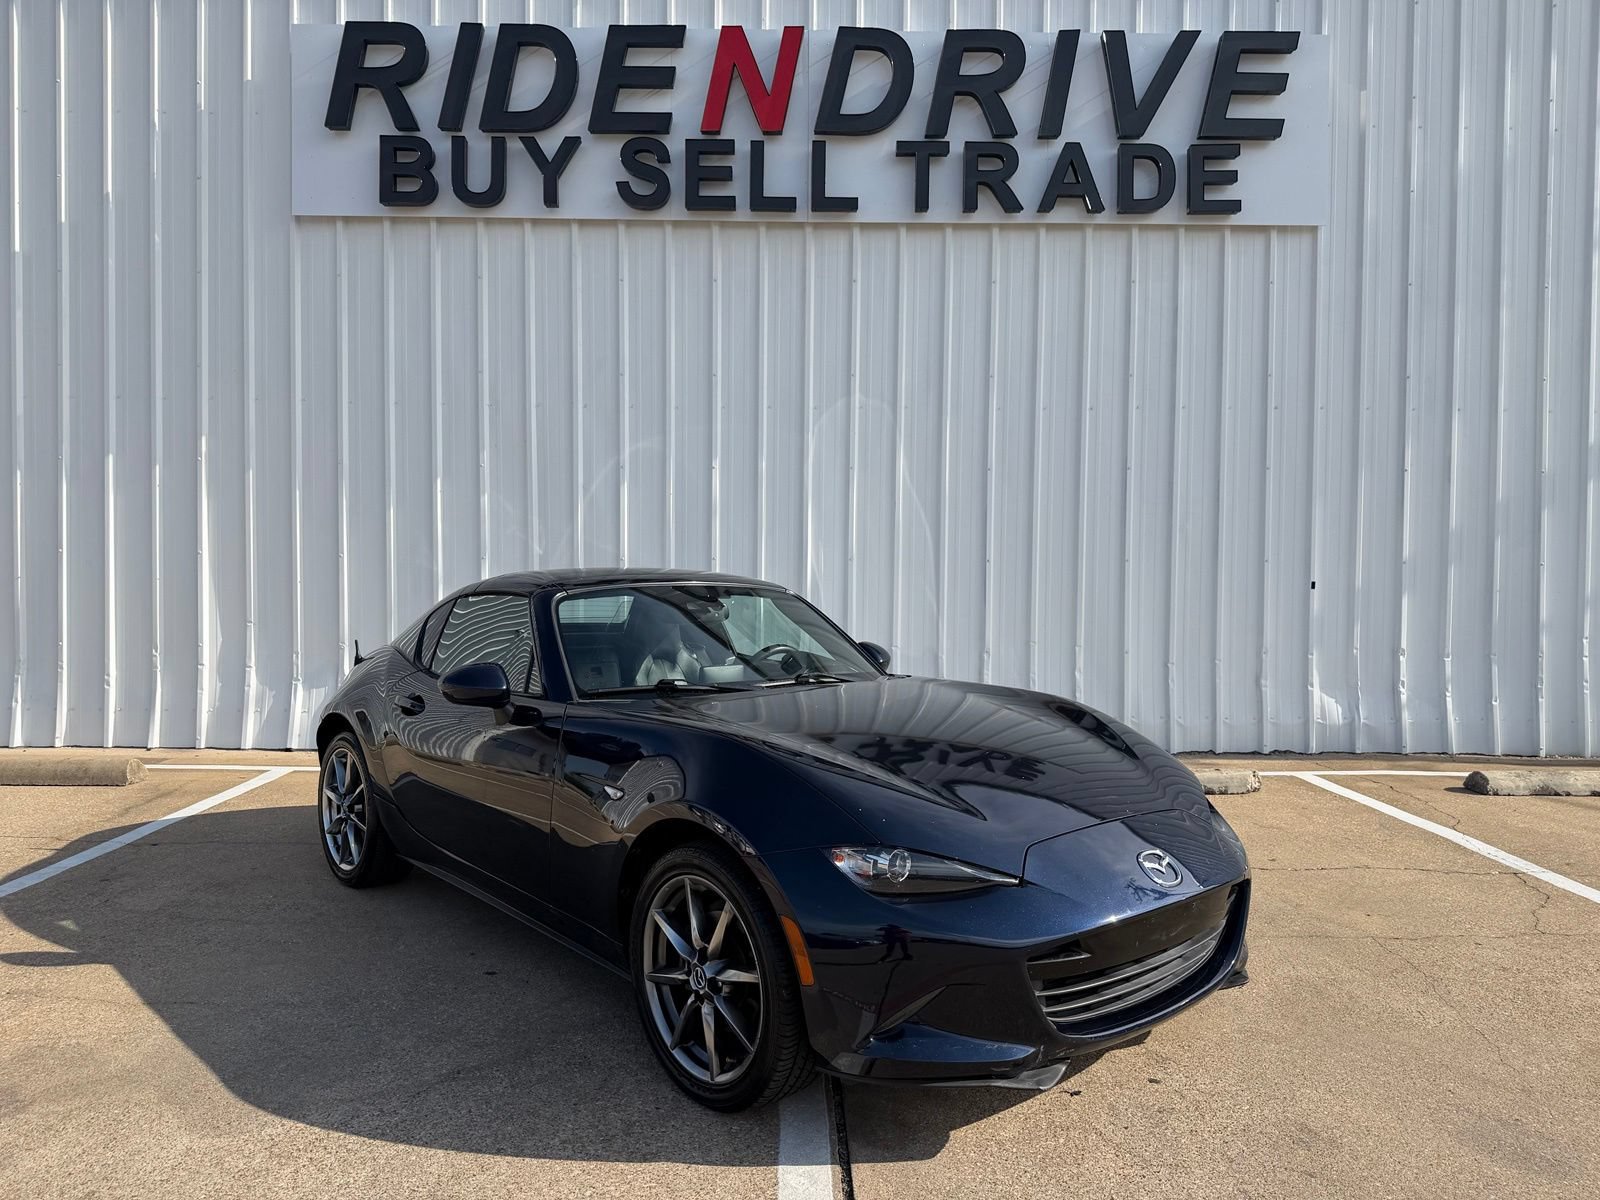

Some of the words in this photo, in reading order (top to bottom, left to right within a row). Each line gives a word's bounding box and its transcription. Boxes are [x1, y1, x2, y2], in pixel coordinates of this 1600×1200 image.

[324, 21, 1300, 140] RIDENDRIVE
[379, 135, 582, 208] BUY
[616, 137, 858, 213] SELL
[896, 141, 1242, 215] TRADE
